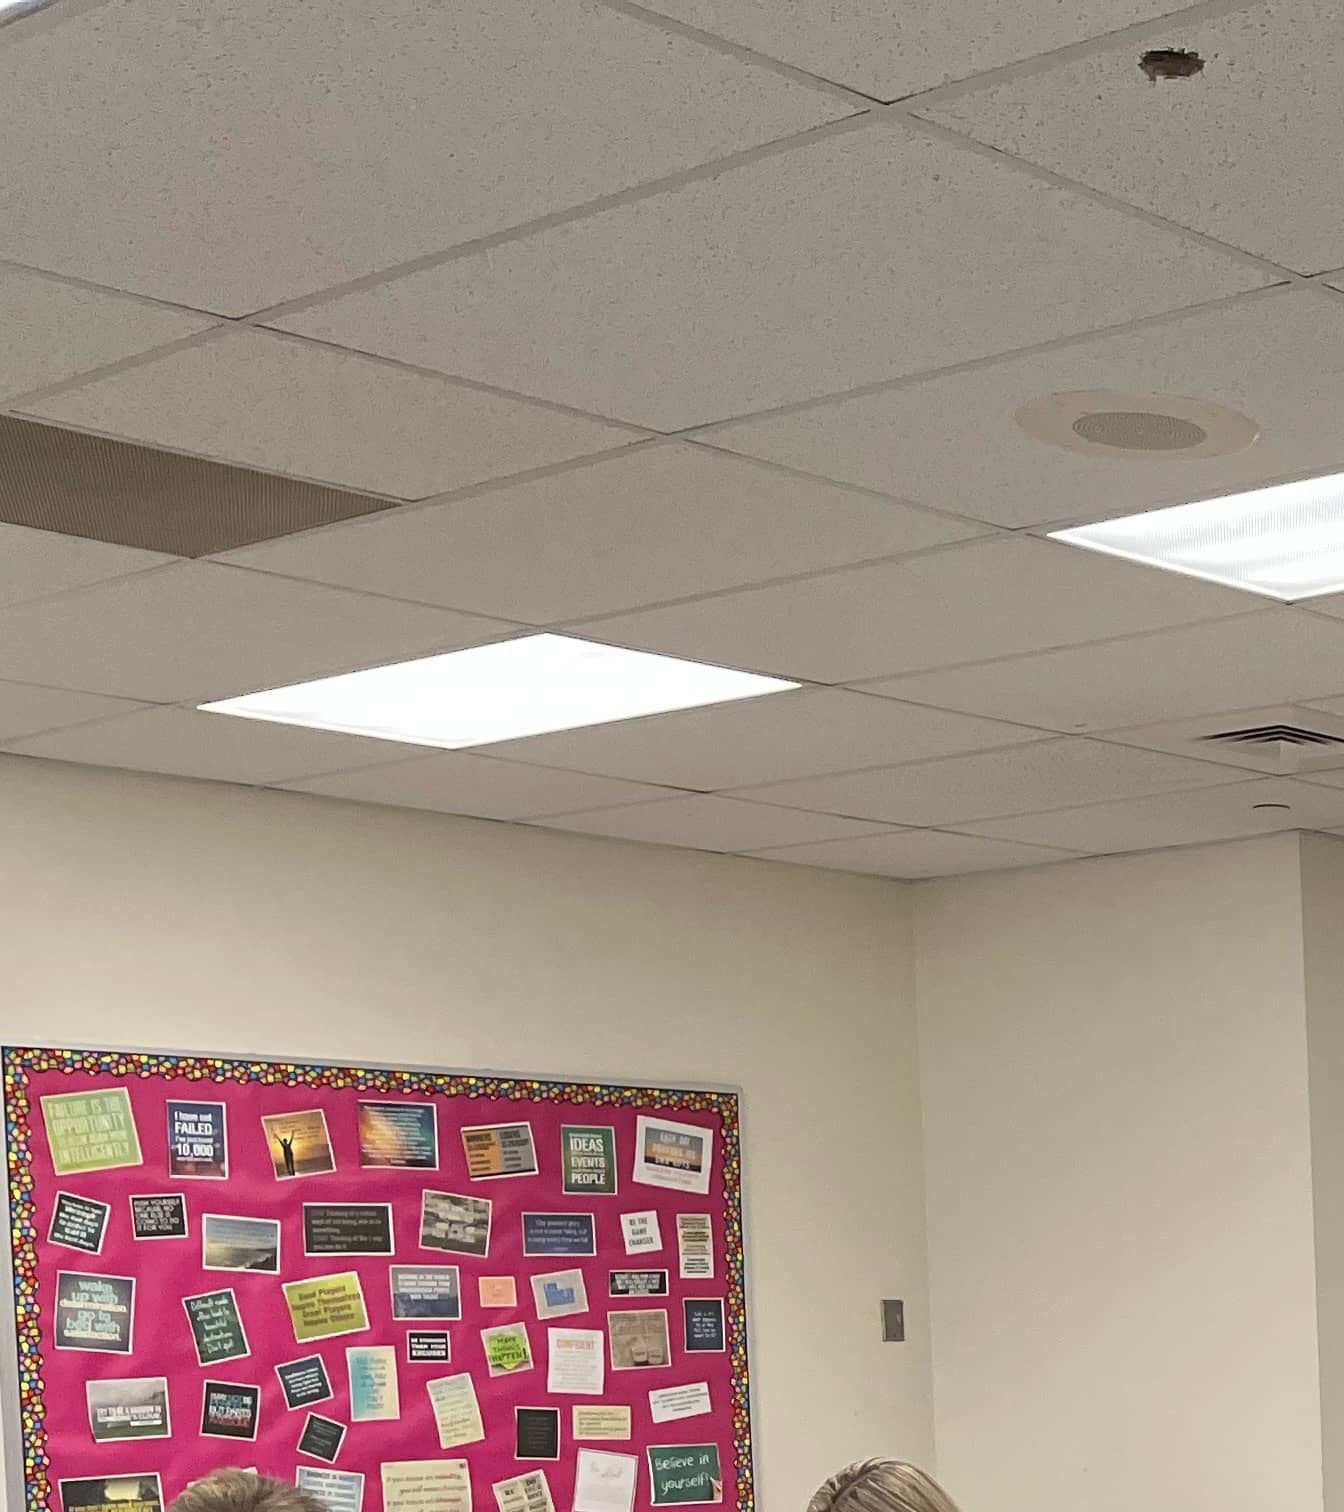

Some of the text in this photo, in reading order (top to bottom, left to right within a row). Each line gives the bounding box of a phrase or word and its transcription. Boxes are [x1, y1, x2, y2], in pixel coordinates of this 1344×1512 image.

[174, 1122, 213, 1136] FAILED
[176, 1143, 214, 1158] 10,000
[569, 1138, 604, 1152] IDEAS
[571, 1157, 606, 1169] EVENTS
[571, 1173, 606, 1185] PEOPLE
[654, 1454, 711, 1471] Believe in
